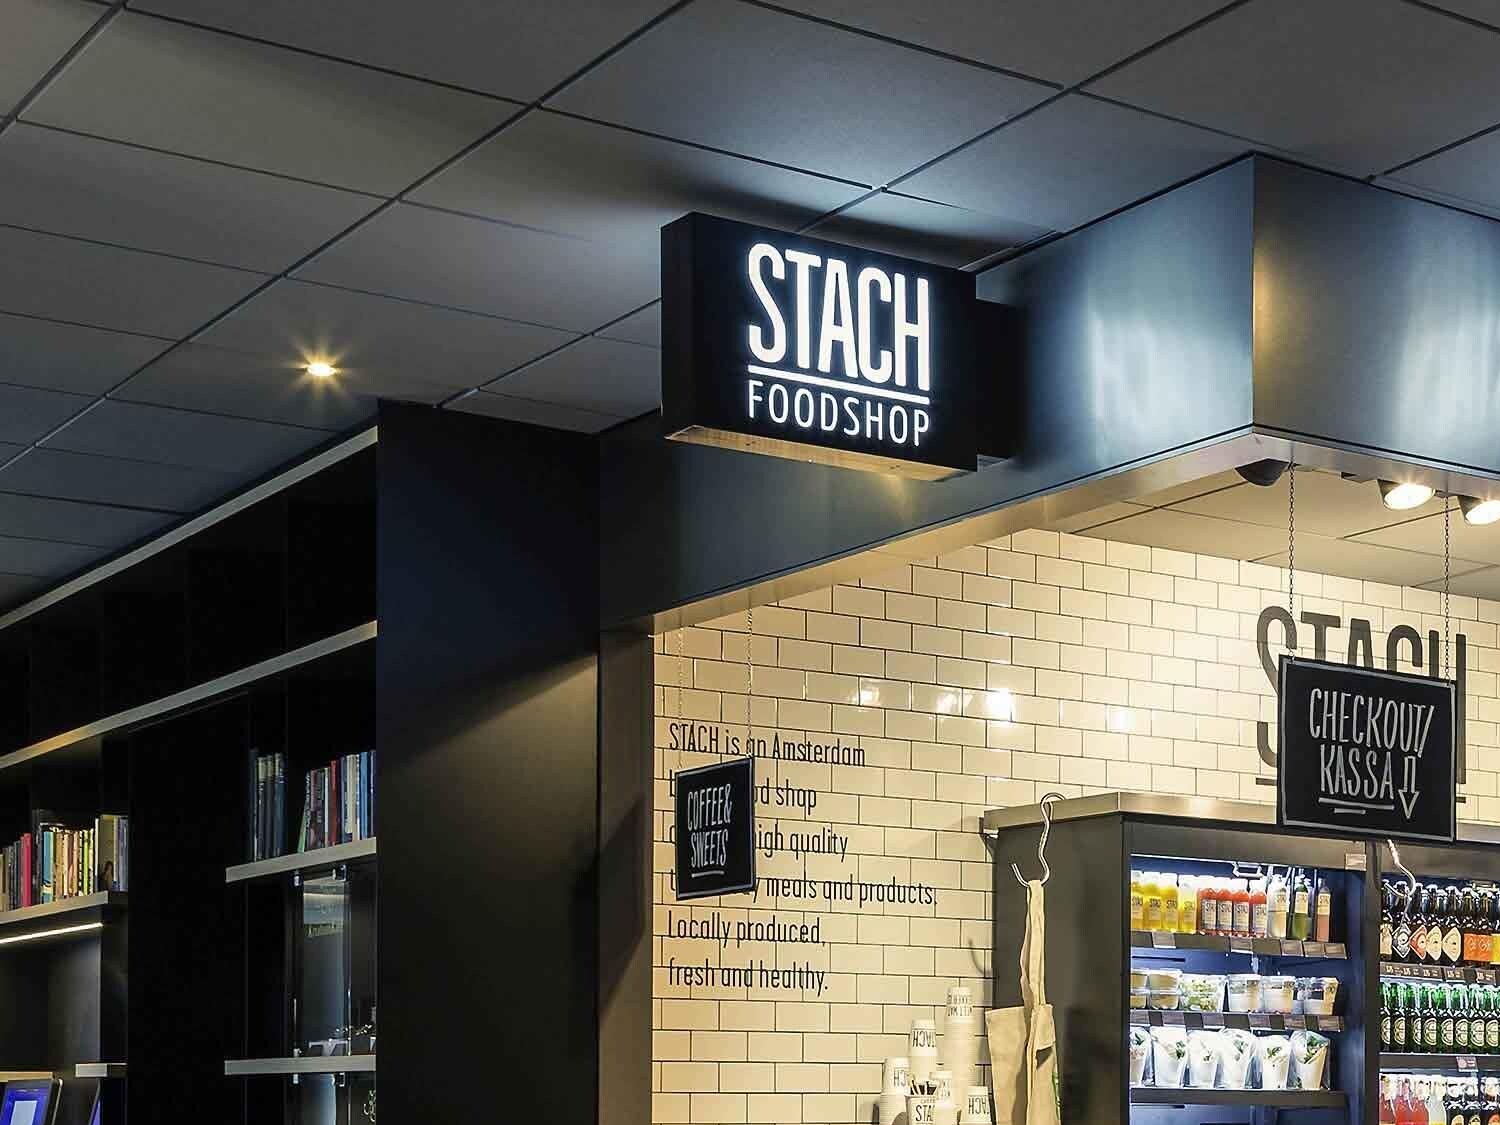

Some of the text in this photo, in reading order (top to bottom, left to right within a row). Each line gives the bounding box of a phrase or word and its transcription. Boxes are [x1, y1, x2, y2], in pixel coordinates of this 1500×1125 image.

[747, 243, 931, 391] STACH
[747, 380, 931, 447] FOODSHOP
[668, 722, 719, 754] STACH
[725, 729, 741, 755] is
[772, 732, 867, 768] Amsterdam
[1320, 744, 1395, 800] KASSA
[775, 782, 818, 816] shop
[690, 828, 729, 870] SWEETS
[789, 827, 849, 862] quality
[766, 871, 818, 900] meals
[823, 873, 854, 902] and
[668, 910, 731, 949] Locally
[668, 956, 829, 997] fresh and healthy.
